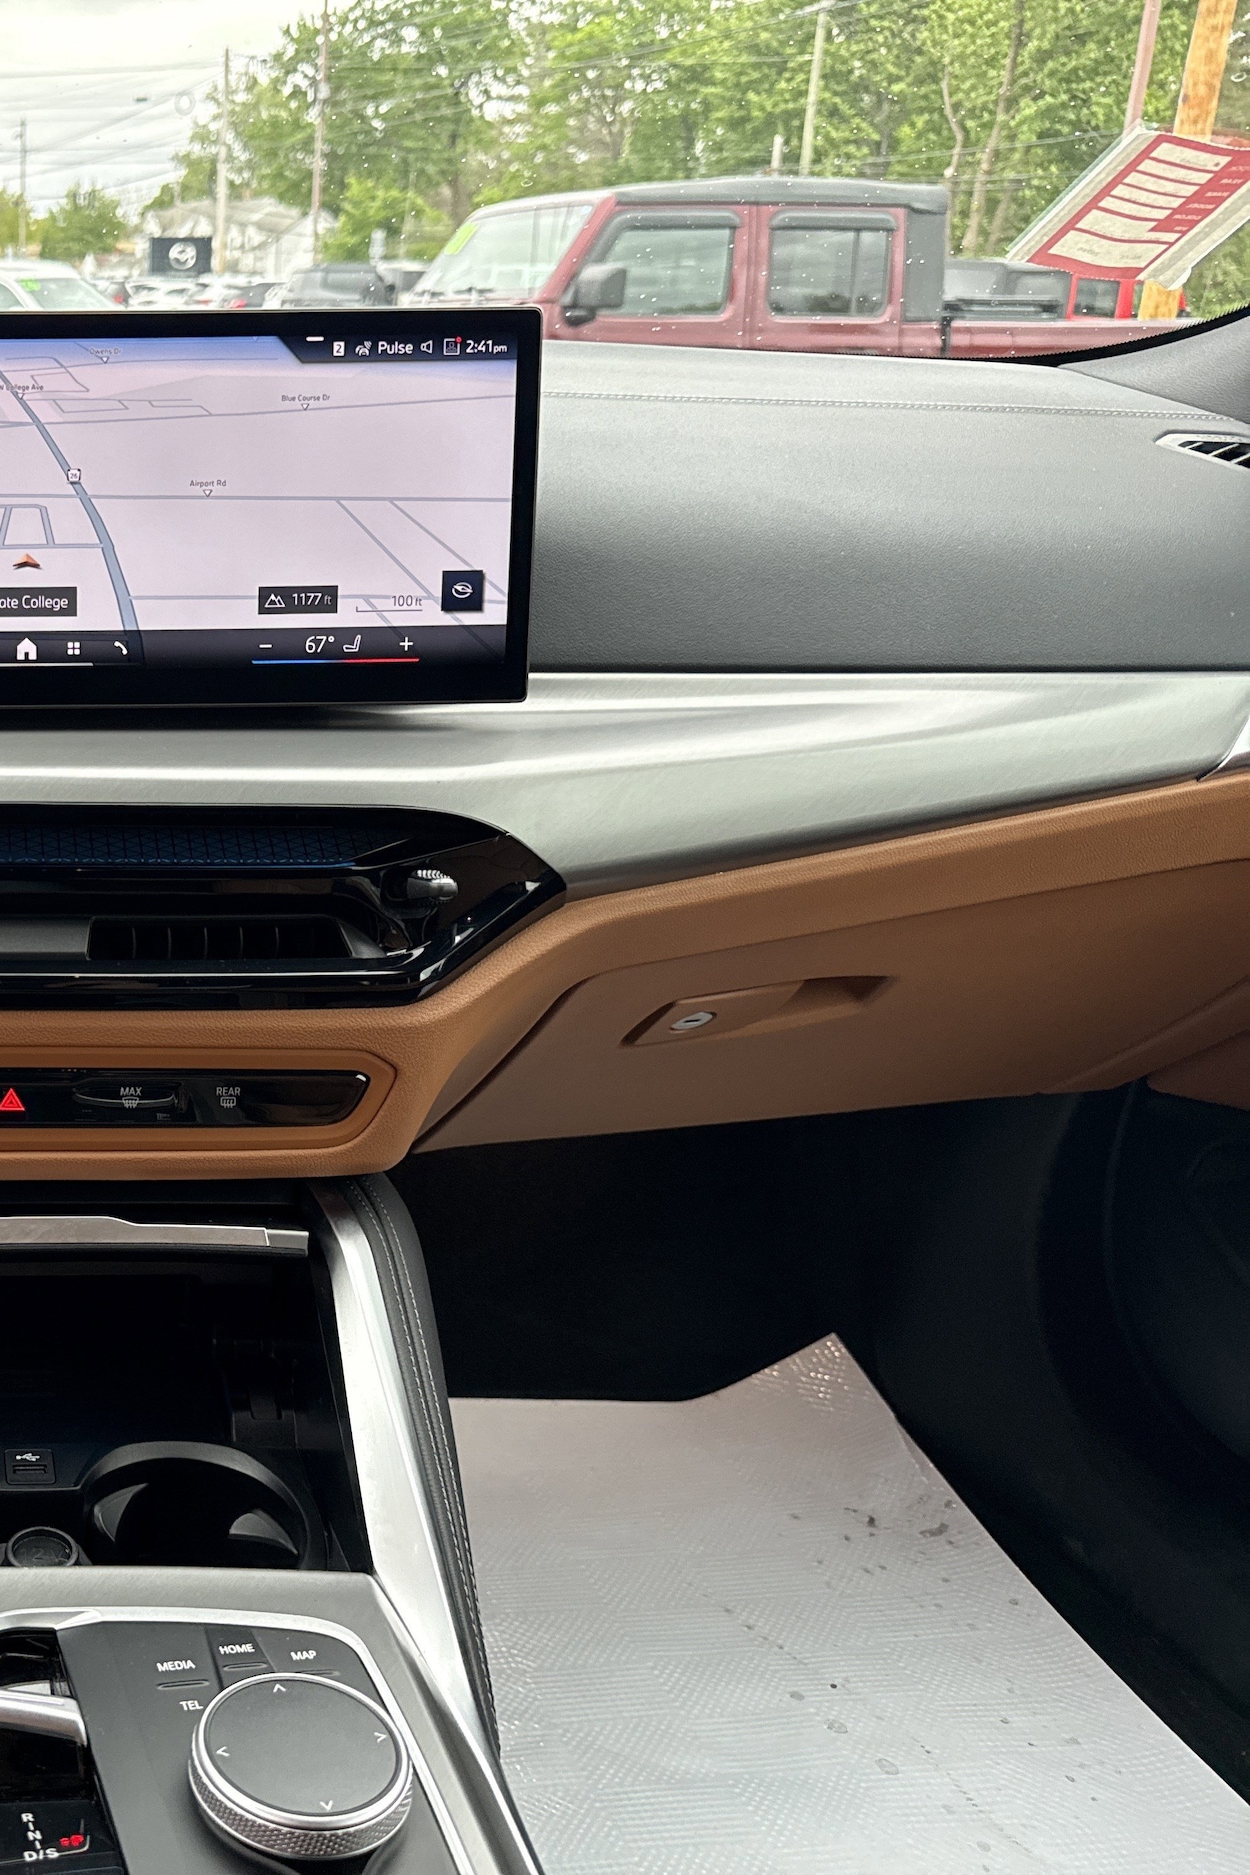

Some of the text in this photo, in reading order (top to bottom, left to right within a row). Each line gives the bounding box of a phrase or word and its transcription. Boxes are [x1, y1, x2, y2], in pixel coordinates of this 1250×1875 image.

[378, 341, 413, 354] Pulse
[322, 393, 330, 401] Dr
[189, 479, 227, 488] Airport Rd
[21, 594, 69, 611] College
[292, 593, 332, 606] 1177 ft
[391, 595, 423, 607] 100 ft
[120, 1086, 142, 1097] MAX
[216, 1086, 241, 1096] REAR
[218, 1643, 255, 1655] HOME
[290, 1650, 317, 1661] MAP
[156, 1659, 196, 1672] MEDIA
[179, 1700, 204, 1712] TEL
[21, 1812, 35, 1822] R
[27, 1830, 43, 1841] N
